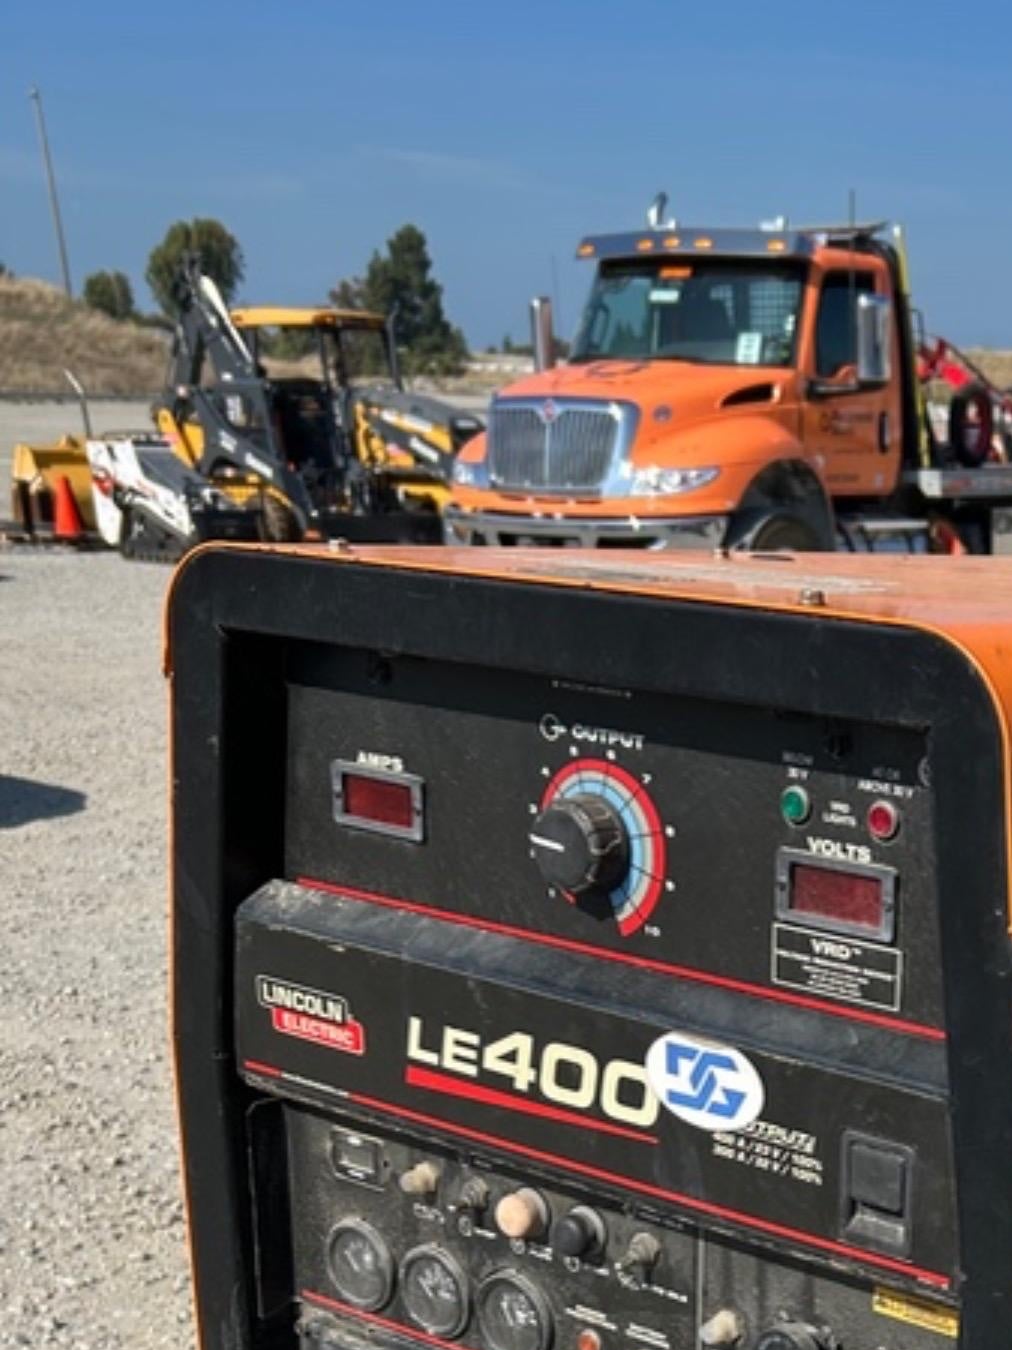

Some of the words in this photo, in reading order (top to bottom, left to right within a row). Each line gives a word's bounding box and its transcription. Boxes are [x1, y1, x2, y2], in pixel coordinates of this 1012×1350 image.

[571, 723, 645, 751] OUTPUT
[356, 751, 404, 773] AMPS
[806, 836, 872, 864] VOLTS
[262, 981, 344, 1024] LINCOLN
[282, 1011, 355, 1047] ELECTRIC
[406, 1016, 659, 1127] LE400
